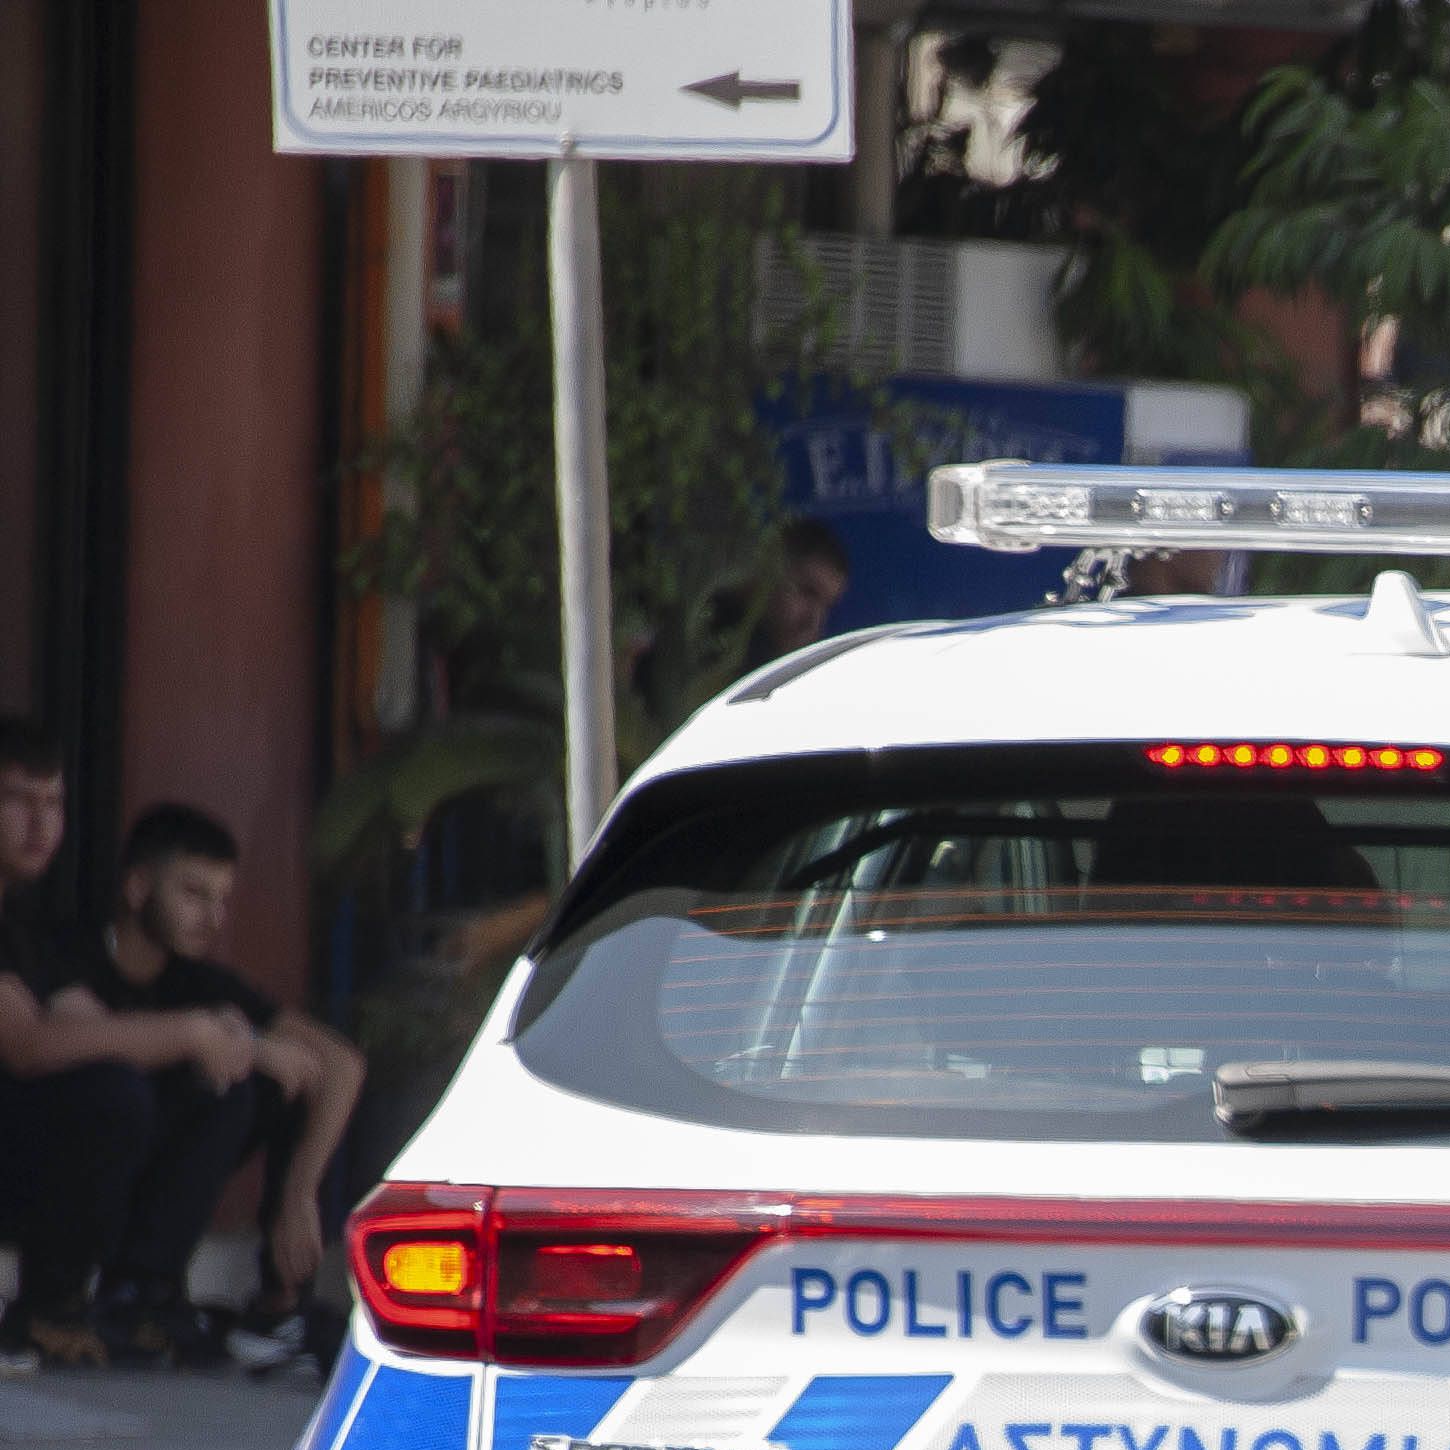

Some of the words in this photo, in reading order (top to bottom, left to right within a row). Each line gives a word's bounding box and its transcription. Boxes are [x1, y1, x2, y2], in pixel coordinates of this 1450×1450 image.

[308, 35, 404, 58] CENTER
[412, 36, 463, 60] FOR
[308, 67, 457, 91] PREVENTIVE
[464, 69, 624, 95] PAEDIATRICS
[308, 98, 433, 121] AMERICOS
[791, 1267, 1089, 1338] POLICE
[1164, 1302, 1274, 1353] KIA
